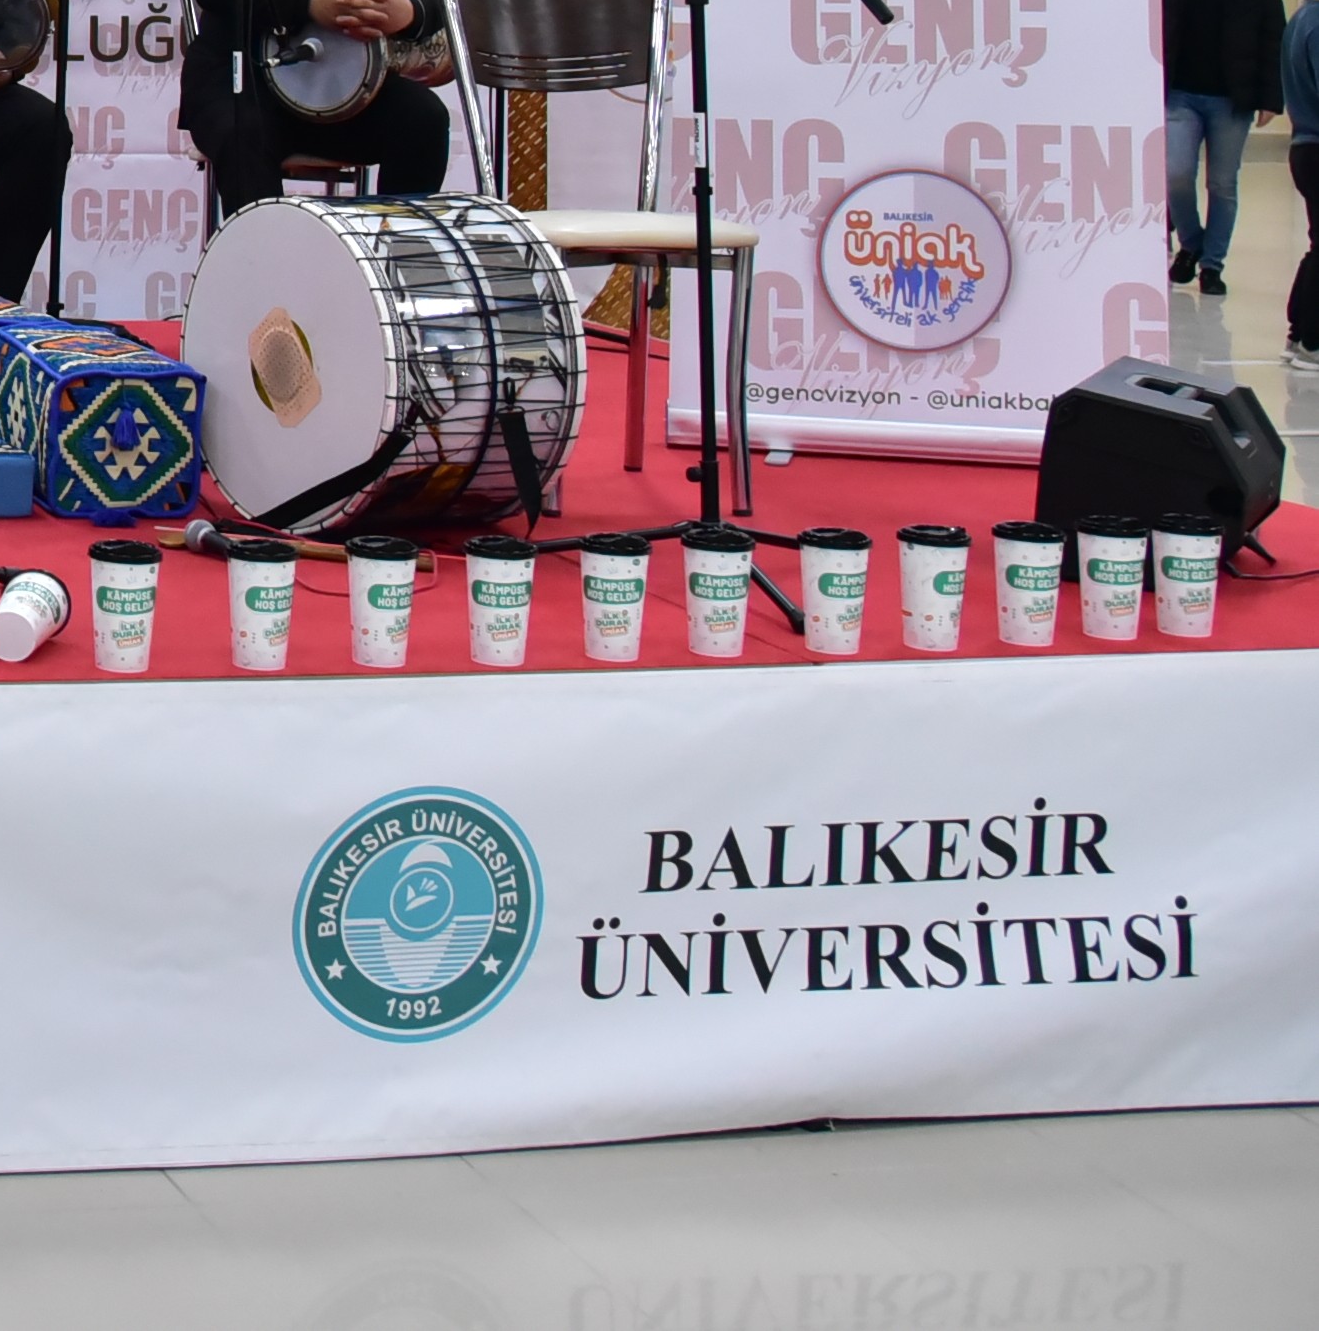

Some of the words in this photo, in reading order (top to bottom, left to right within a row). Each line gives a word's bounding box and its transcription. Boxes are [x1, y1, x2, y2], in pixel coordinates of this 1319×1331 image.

[70, 187, 199, 253] GENÇ
[844, 210, 985, 280] üniak
[883, 212, 934, 222] BALIKESİR
[849, 274, 913, 327] üniversiteli
[916, 311, 941, 326] ak
[745, 383, 901, 408] @gencvizyon
[317, 814, 404, 938] BALIKESİR
[411, 809, 518, 937] ÜNİVERSİTESİ
[638, 797, 1115, 894] BALIKESİR
[575, 895, 1200, 1001] ÜNİVERSİTESİ
[383, 996, 443, 1022] 1992
